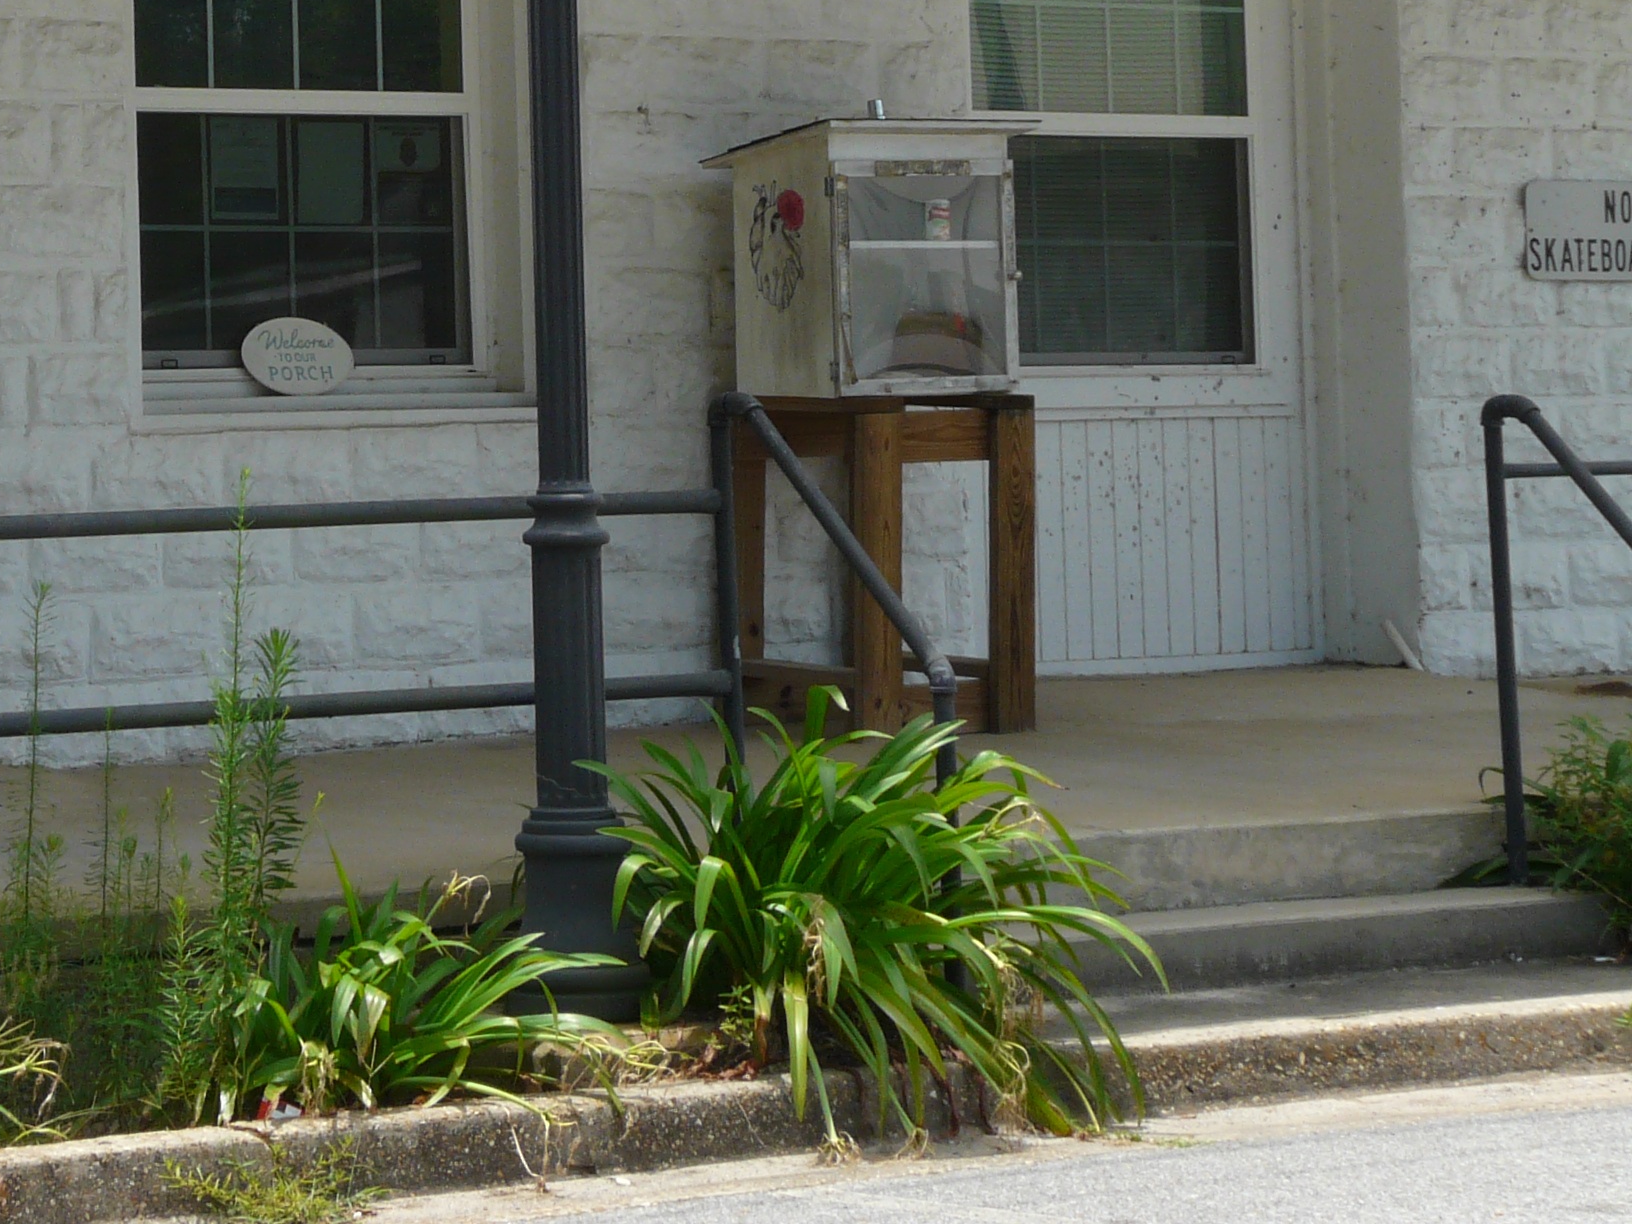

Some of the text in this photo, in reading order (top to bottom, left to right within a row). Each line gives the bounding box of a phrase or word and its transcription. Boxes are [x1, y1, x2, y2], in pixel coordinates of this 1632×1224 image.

[1604, 190, 1632, 224] NO
[1529, 237, 1632, 272] SKATEBO
[258, 328, 335, 349] Welcome
[279, 352, 317, 362] TO OUR
[268, 366, 333, 381] PORCH
